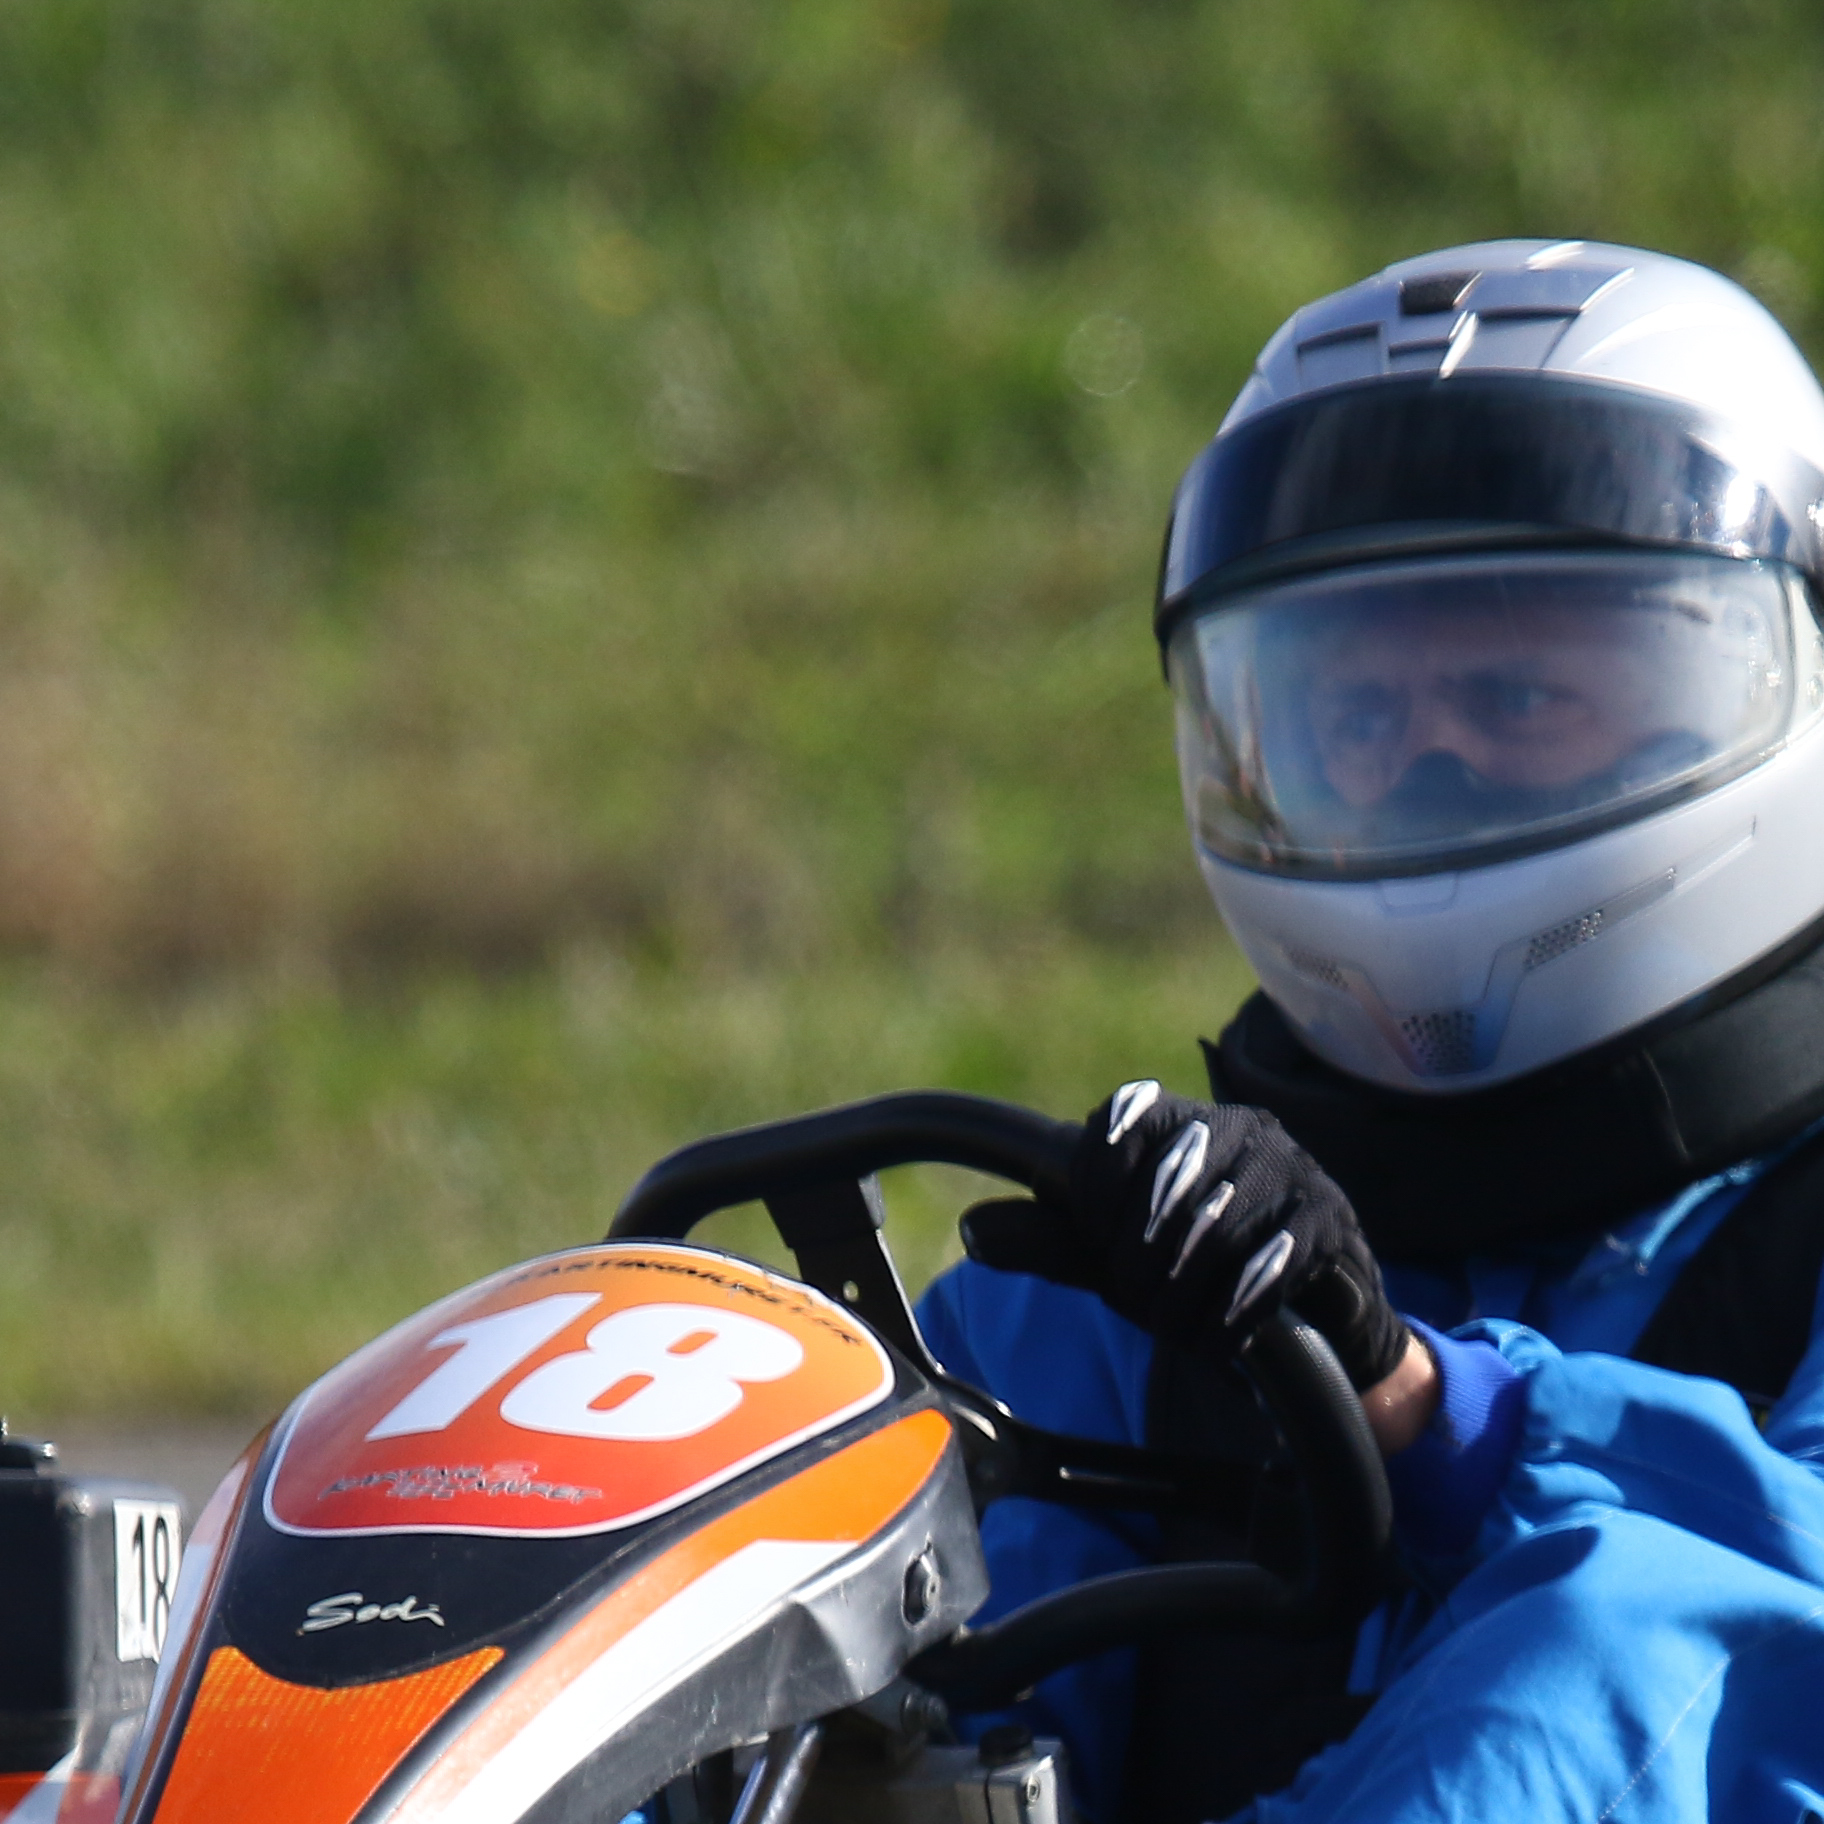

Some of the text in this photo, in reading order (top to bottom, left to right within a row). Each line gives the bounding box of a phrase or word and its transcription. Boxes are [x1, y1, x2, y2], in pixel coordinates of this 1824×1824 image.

[365, 1290, 804, 1441] 18
[132, 1512, 170, 1660] 18
[300, 1590, 446, 1634] Sodi
